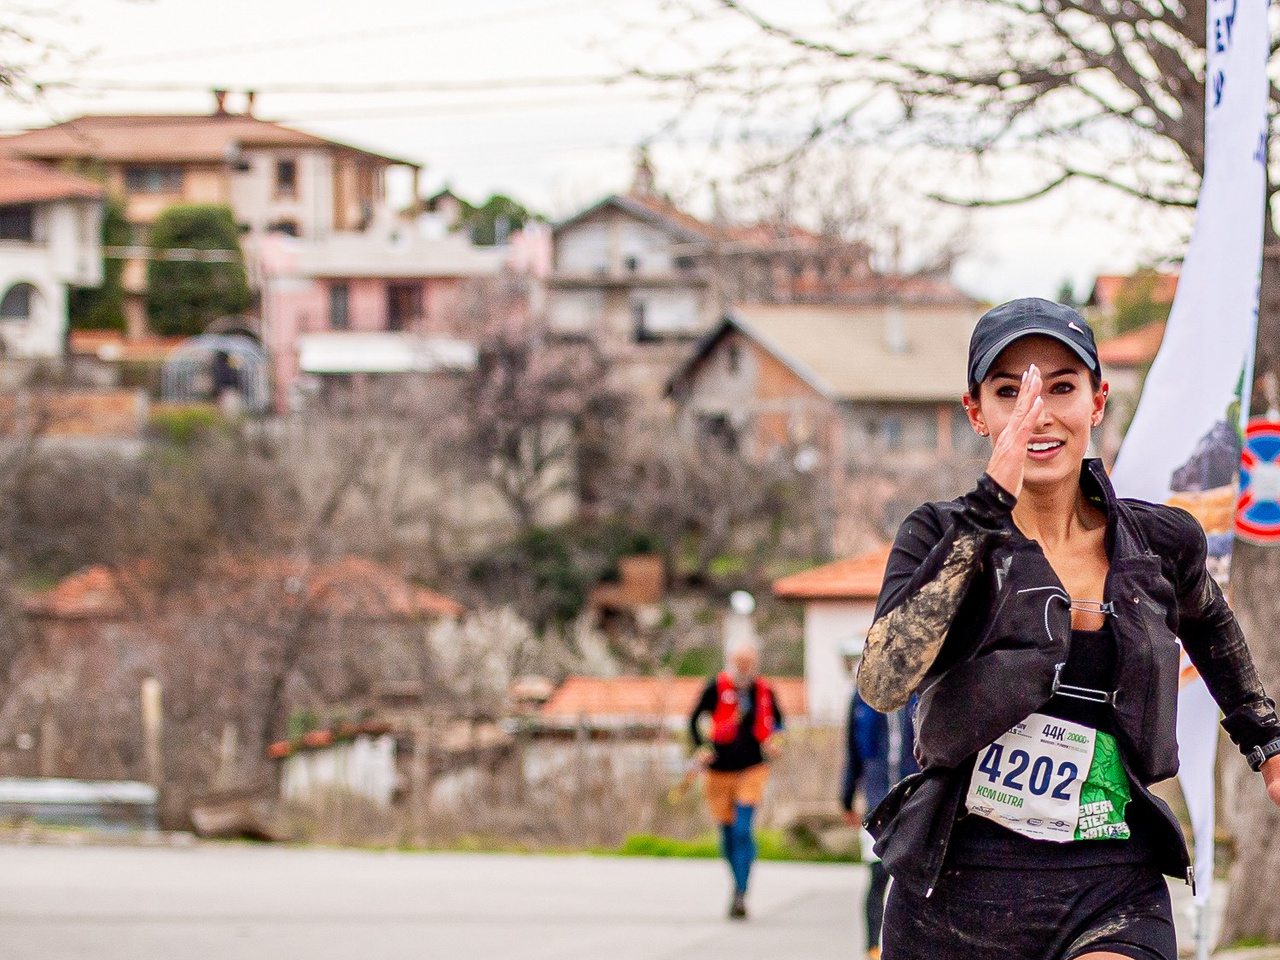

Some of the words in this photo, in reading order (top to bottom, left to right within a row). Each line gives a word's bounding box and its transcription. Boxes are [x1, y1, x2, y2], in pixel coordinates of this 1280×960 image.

[1042, 724, 1066, 741] 44K
[978, 743, 1078, 800] 4202
[997, 791, 1025, 808] ULTRA
